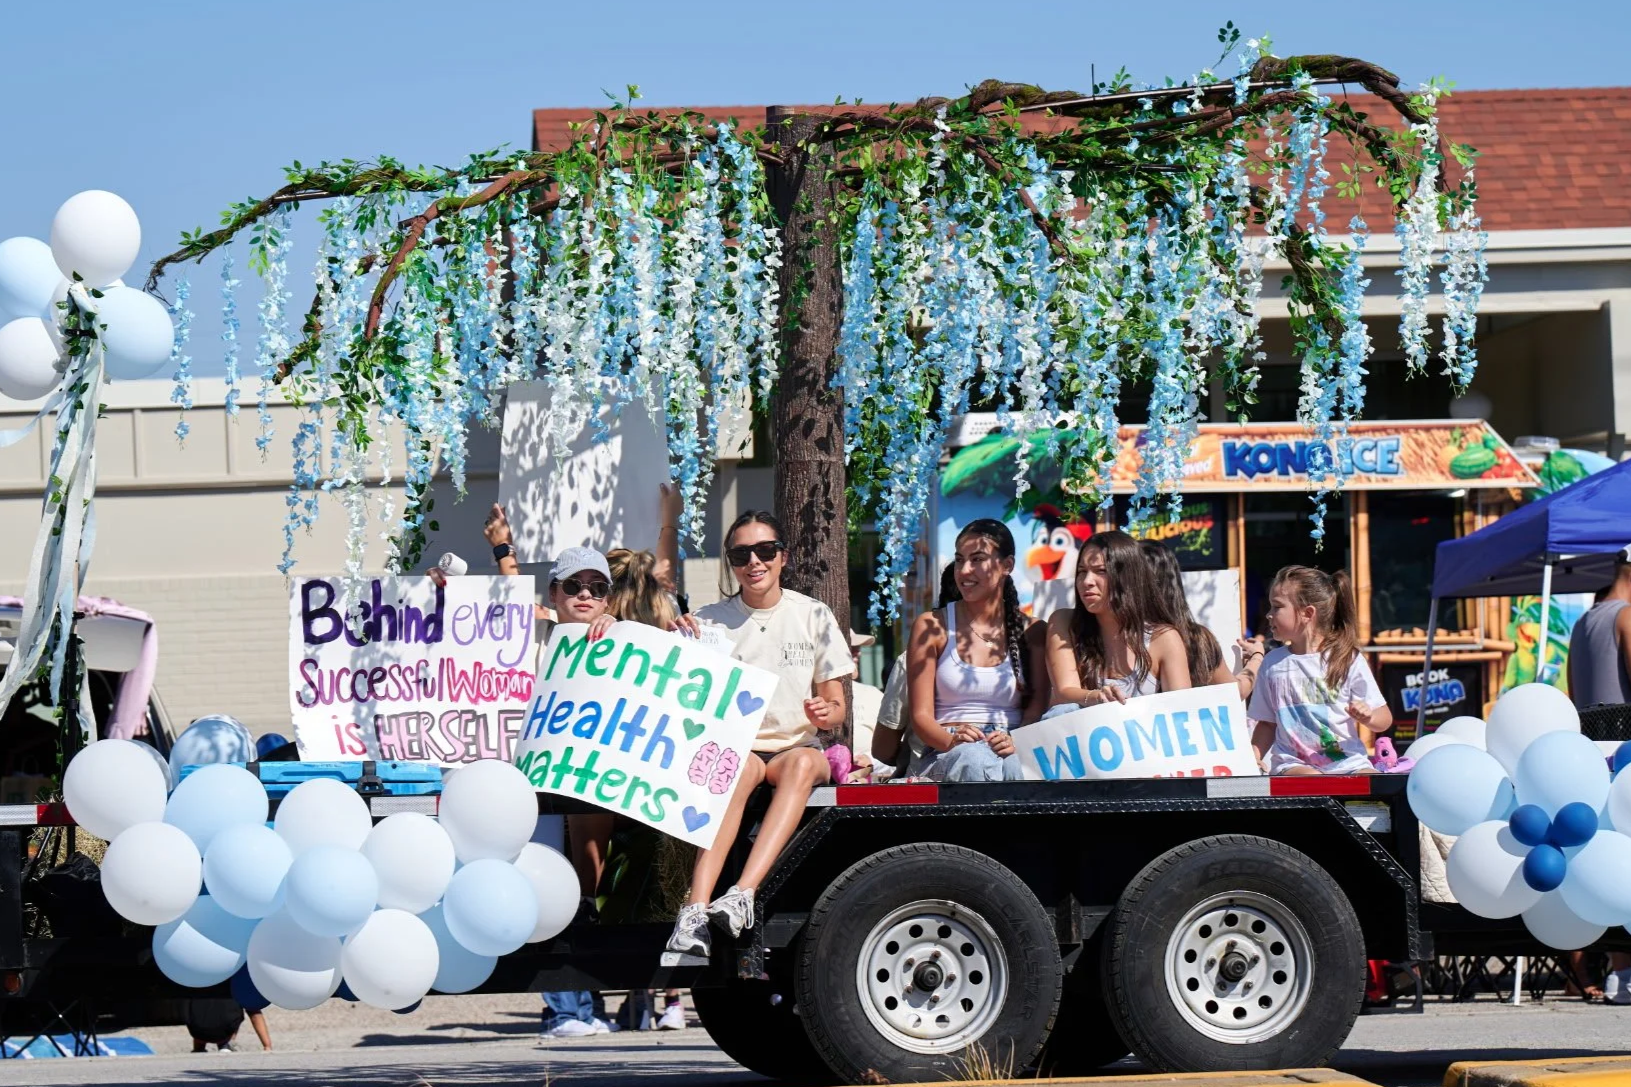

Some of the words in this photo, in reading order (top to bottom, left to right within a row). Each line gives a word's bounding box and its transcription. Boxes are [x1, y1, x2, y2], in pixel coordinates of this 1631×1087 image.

[1222, 440, 1335, 479] KONA
[1336, 437, 1401, 475] ICE
[301, 578, 443, 647] Behind
[451, 601, 534, 668] every
[295, 657, 444, 708] Successful
[446, 657, 536, 705] Woman
[545, 635, 743, 720] Mental
[1405, 668, 1450, 688] BOOK
[333, 714, 367, 756] is
[374, 708, 526, 764] HERSELF
[523, 690, 676, 770] Health
[1032, 705, 1235, 781] WOMEN
